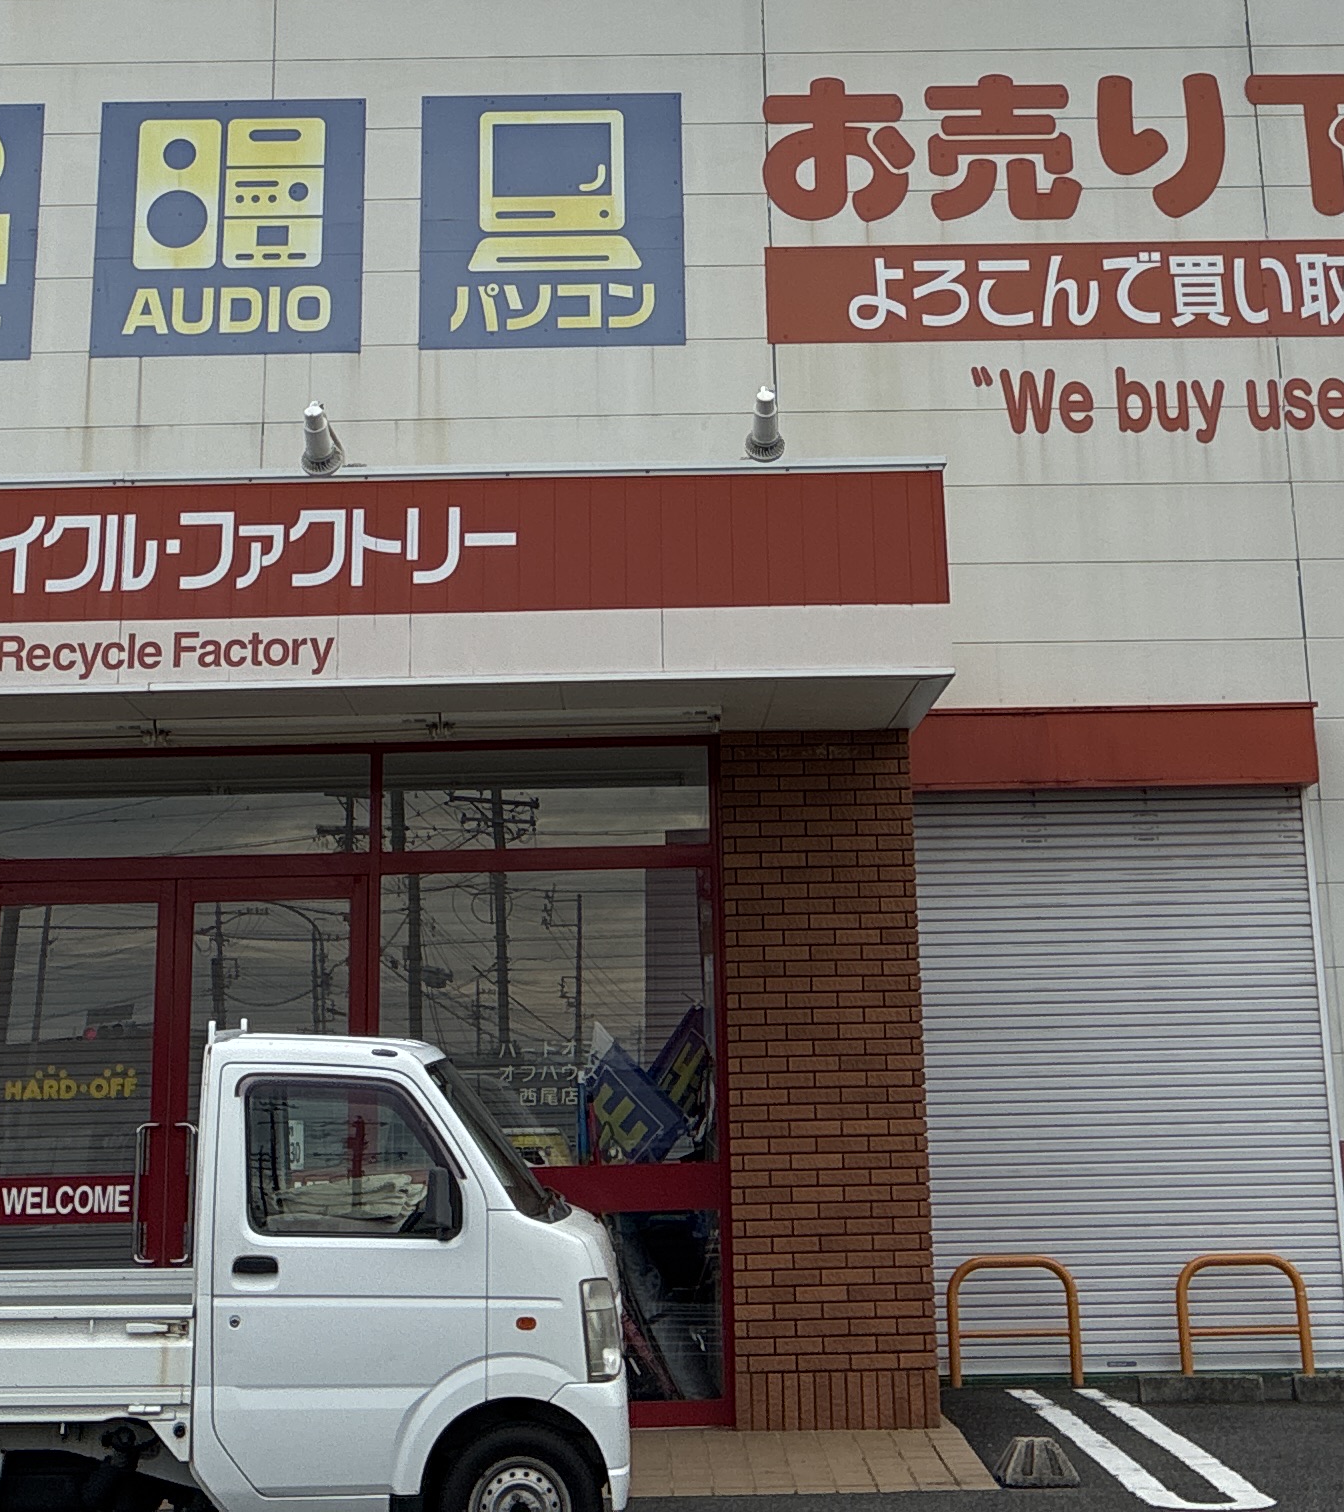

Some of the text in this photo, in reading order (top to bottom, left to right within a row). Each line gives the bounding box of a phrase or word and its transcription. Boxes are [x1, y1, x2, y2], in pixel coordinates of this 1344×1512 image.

[122, 285, 332, 336] AUDIO
[450, 282, 656, 333] パソコン
[1115, 366, 1224, 443] buy
[173, 631, 336, 675] Factory
[519, 1087, 579, 1107] 西尾店
[1, 1184, 131, 1216] WELCOME
